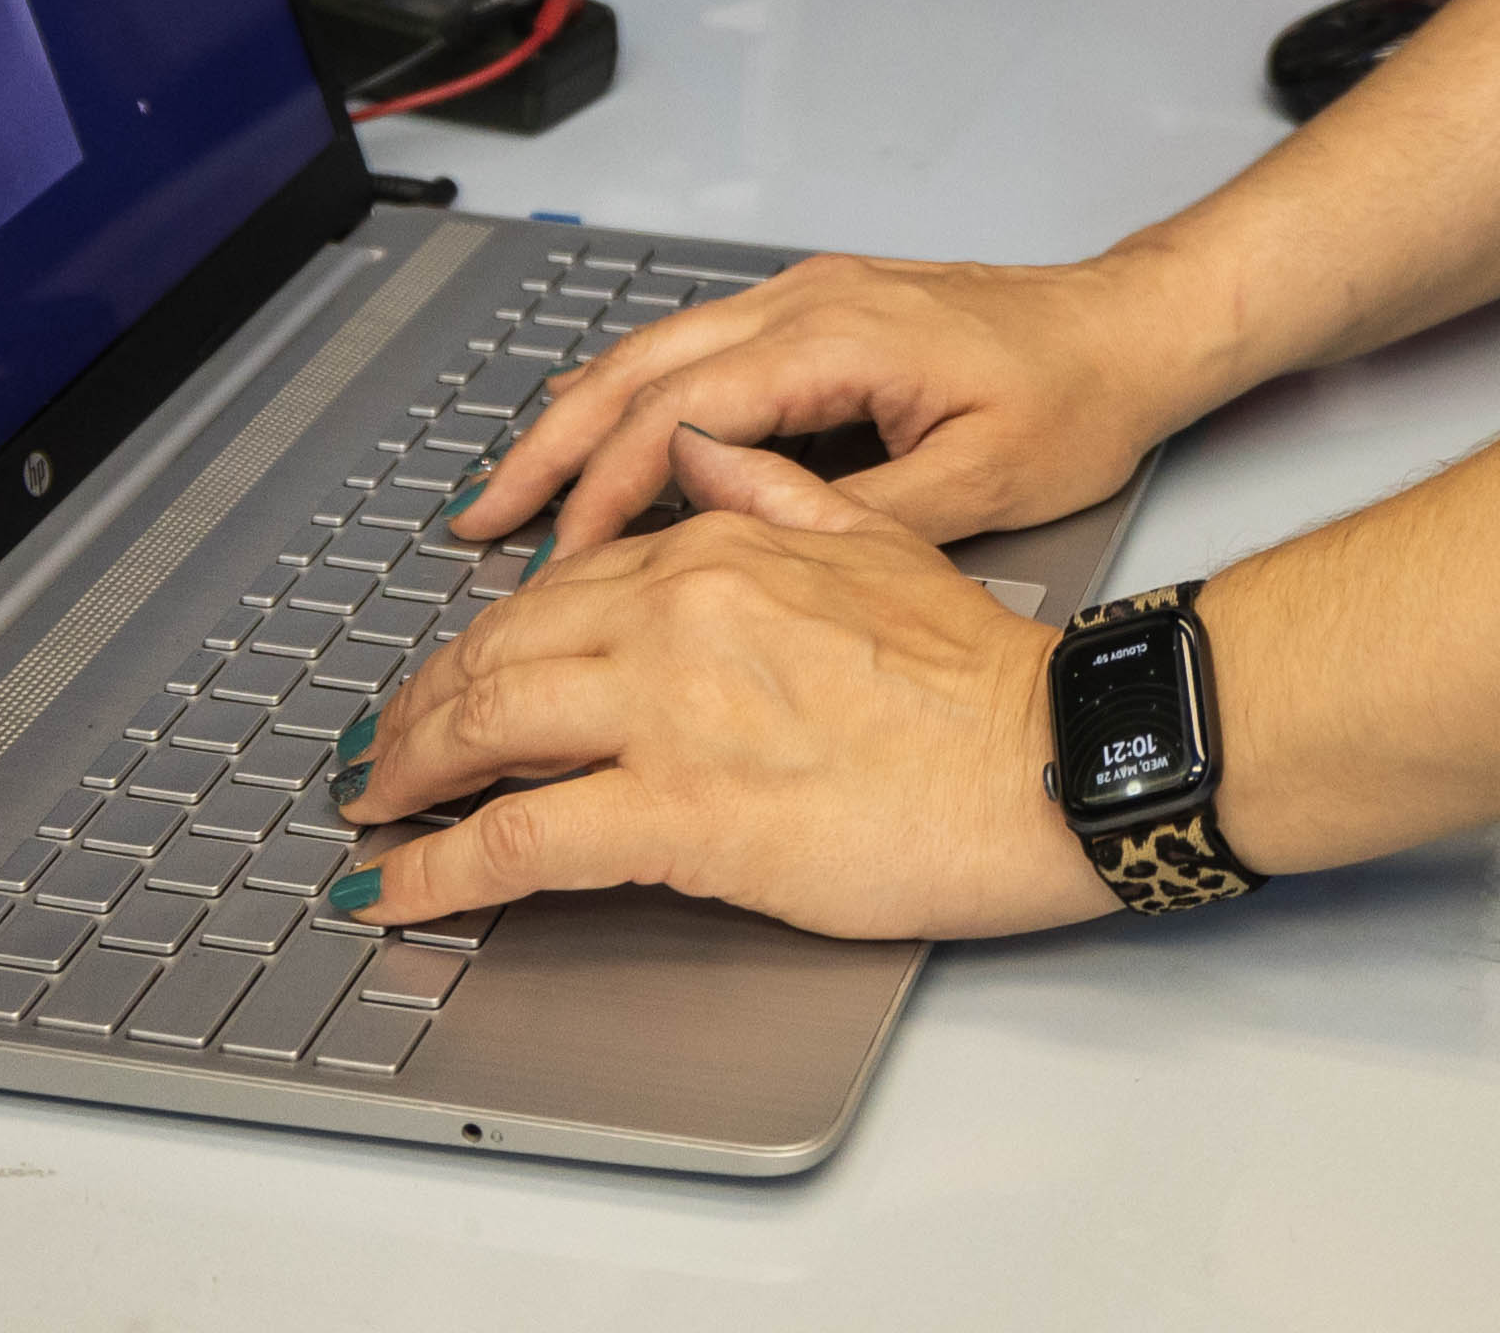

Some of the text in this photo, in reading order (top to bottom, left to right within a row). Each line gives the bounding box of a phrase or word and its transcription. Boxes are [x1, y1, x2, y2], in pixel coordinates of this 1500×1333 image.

[1111, 643, 1148, 661] CLOUDY
[1103, 734, 1157, 767] 10:21
[1096, 756, 1169, 785] WED, MAY 28
